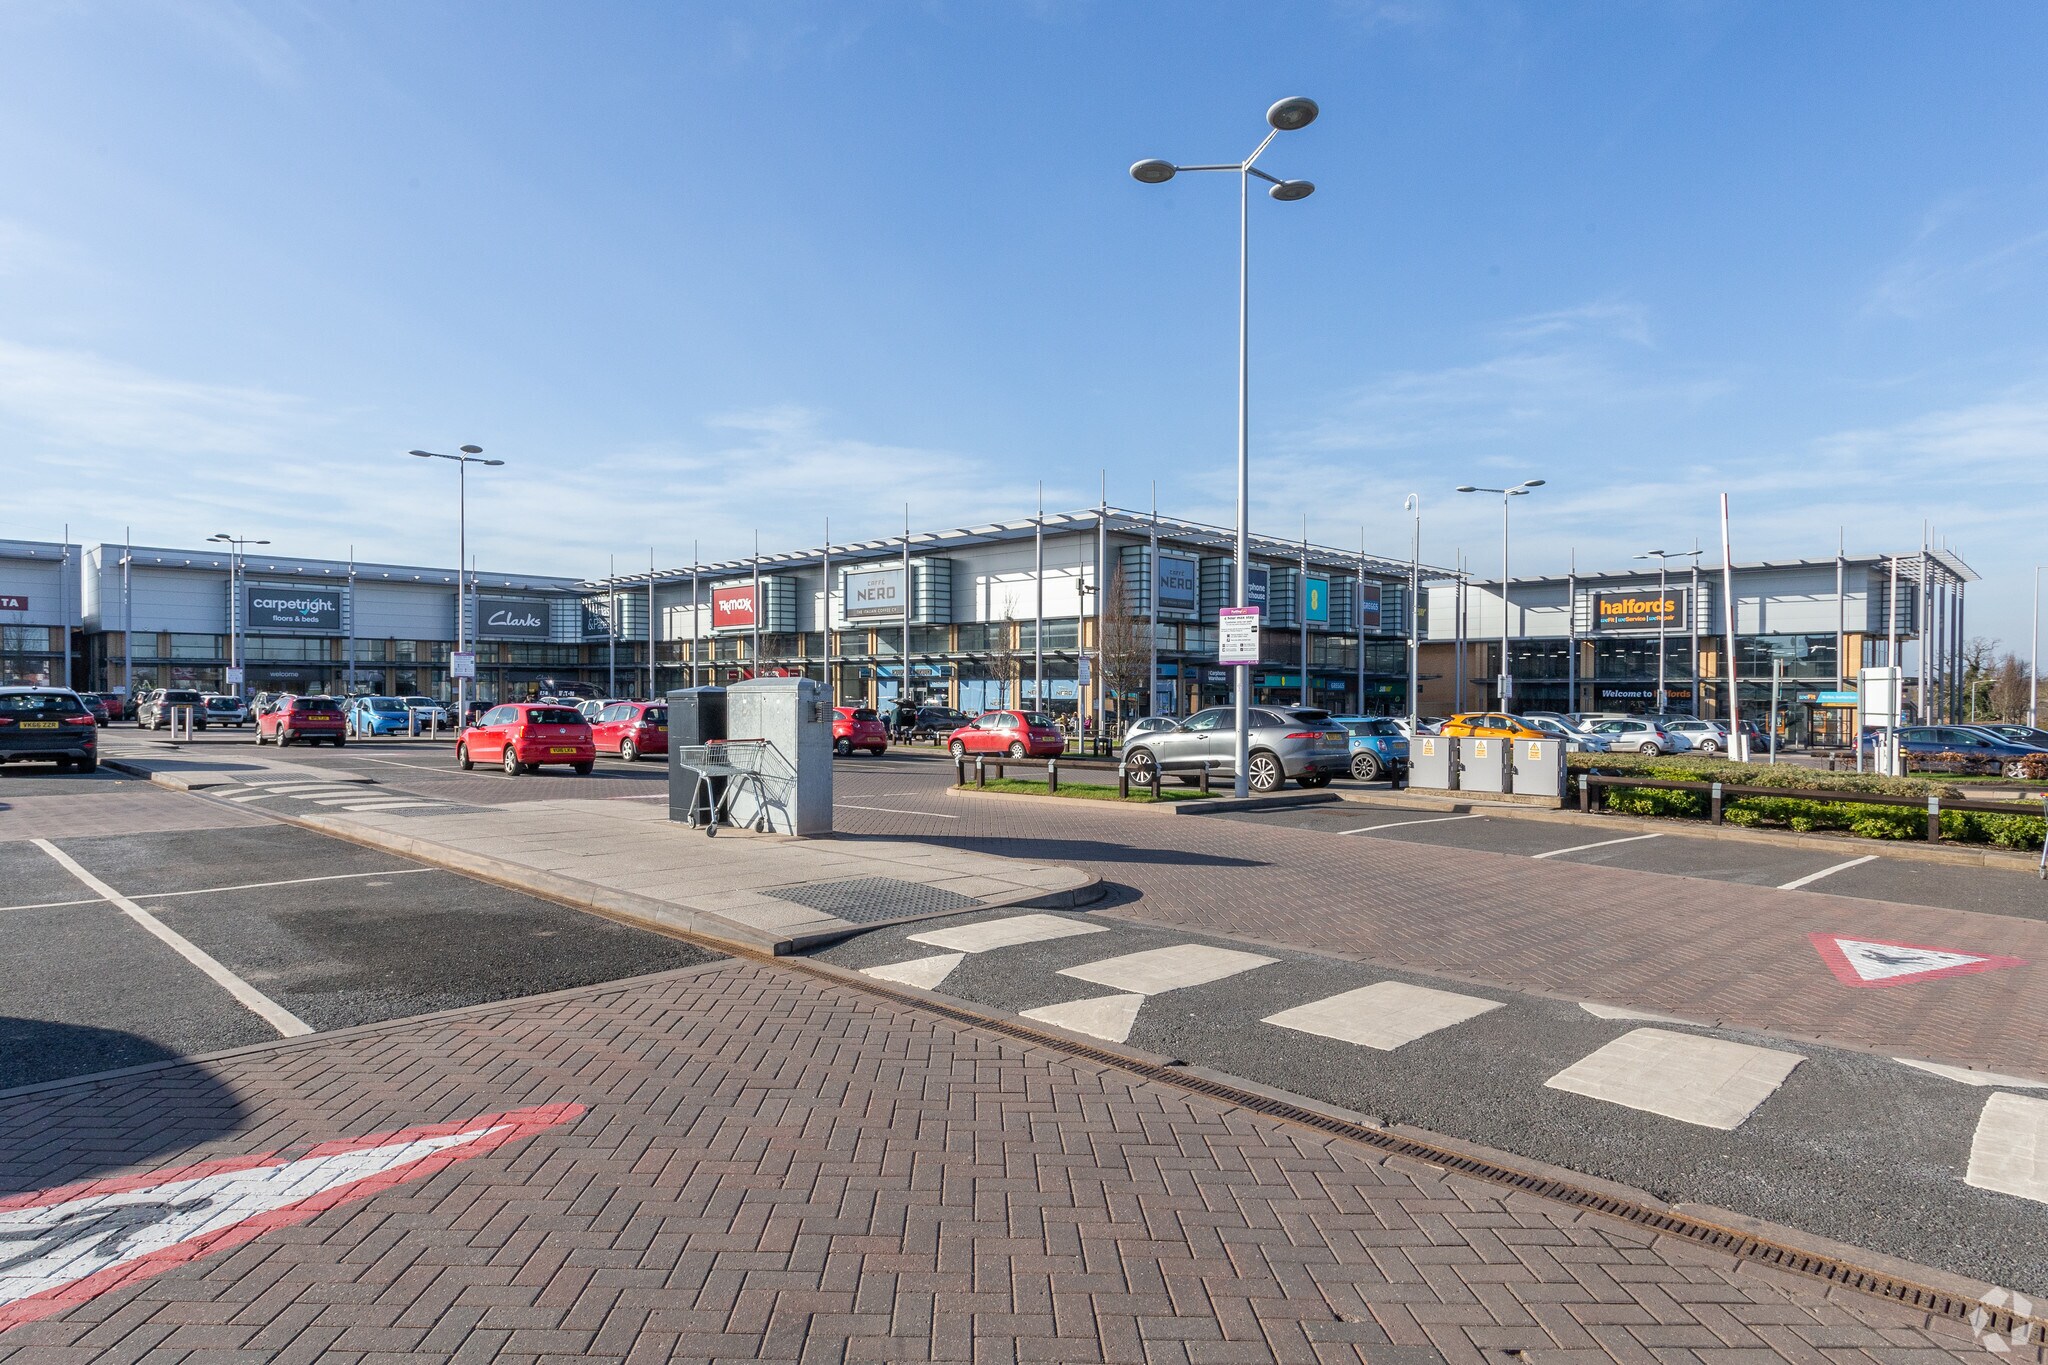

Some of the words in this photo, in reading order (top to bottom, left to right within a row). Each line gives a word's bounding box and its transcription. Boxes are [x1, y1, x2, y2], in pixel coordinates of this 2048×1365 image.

[1160, 576, 1192, 591] NERO
[857, 586, 896, 602] NERO
[1600, 596, 1675, 615] halfords
[272, 614, 294, 622] floors
[301, 615, 320, 623] beds
[487, 610, 541, 627] Clarks
[1602, 689, 1642, 698] Welcome
[1642, 690, 1653, 698] to
